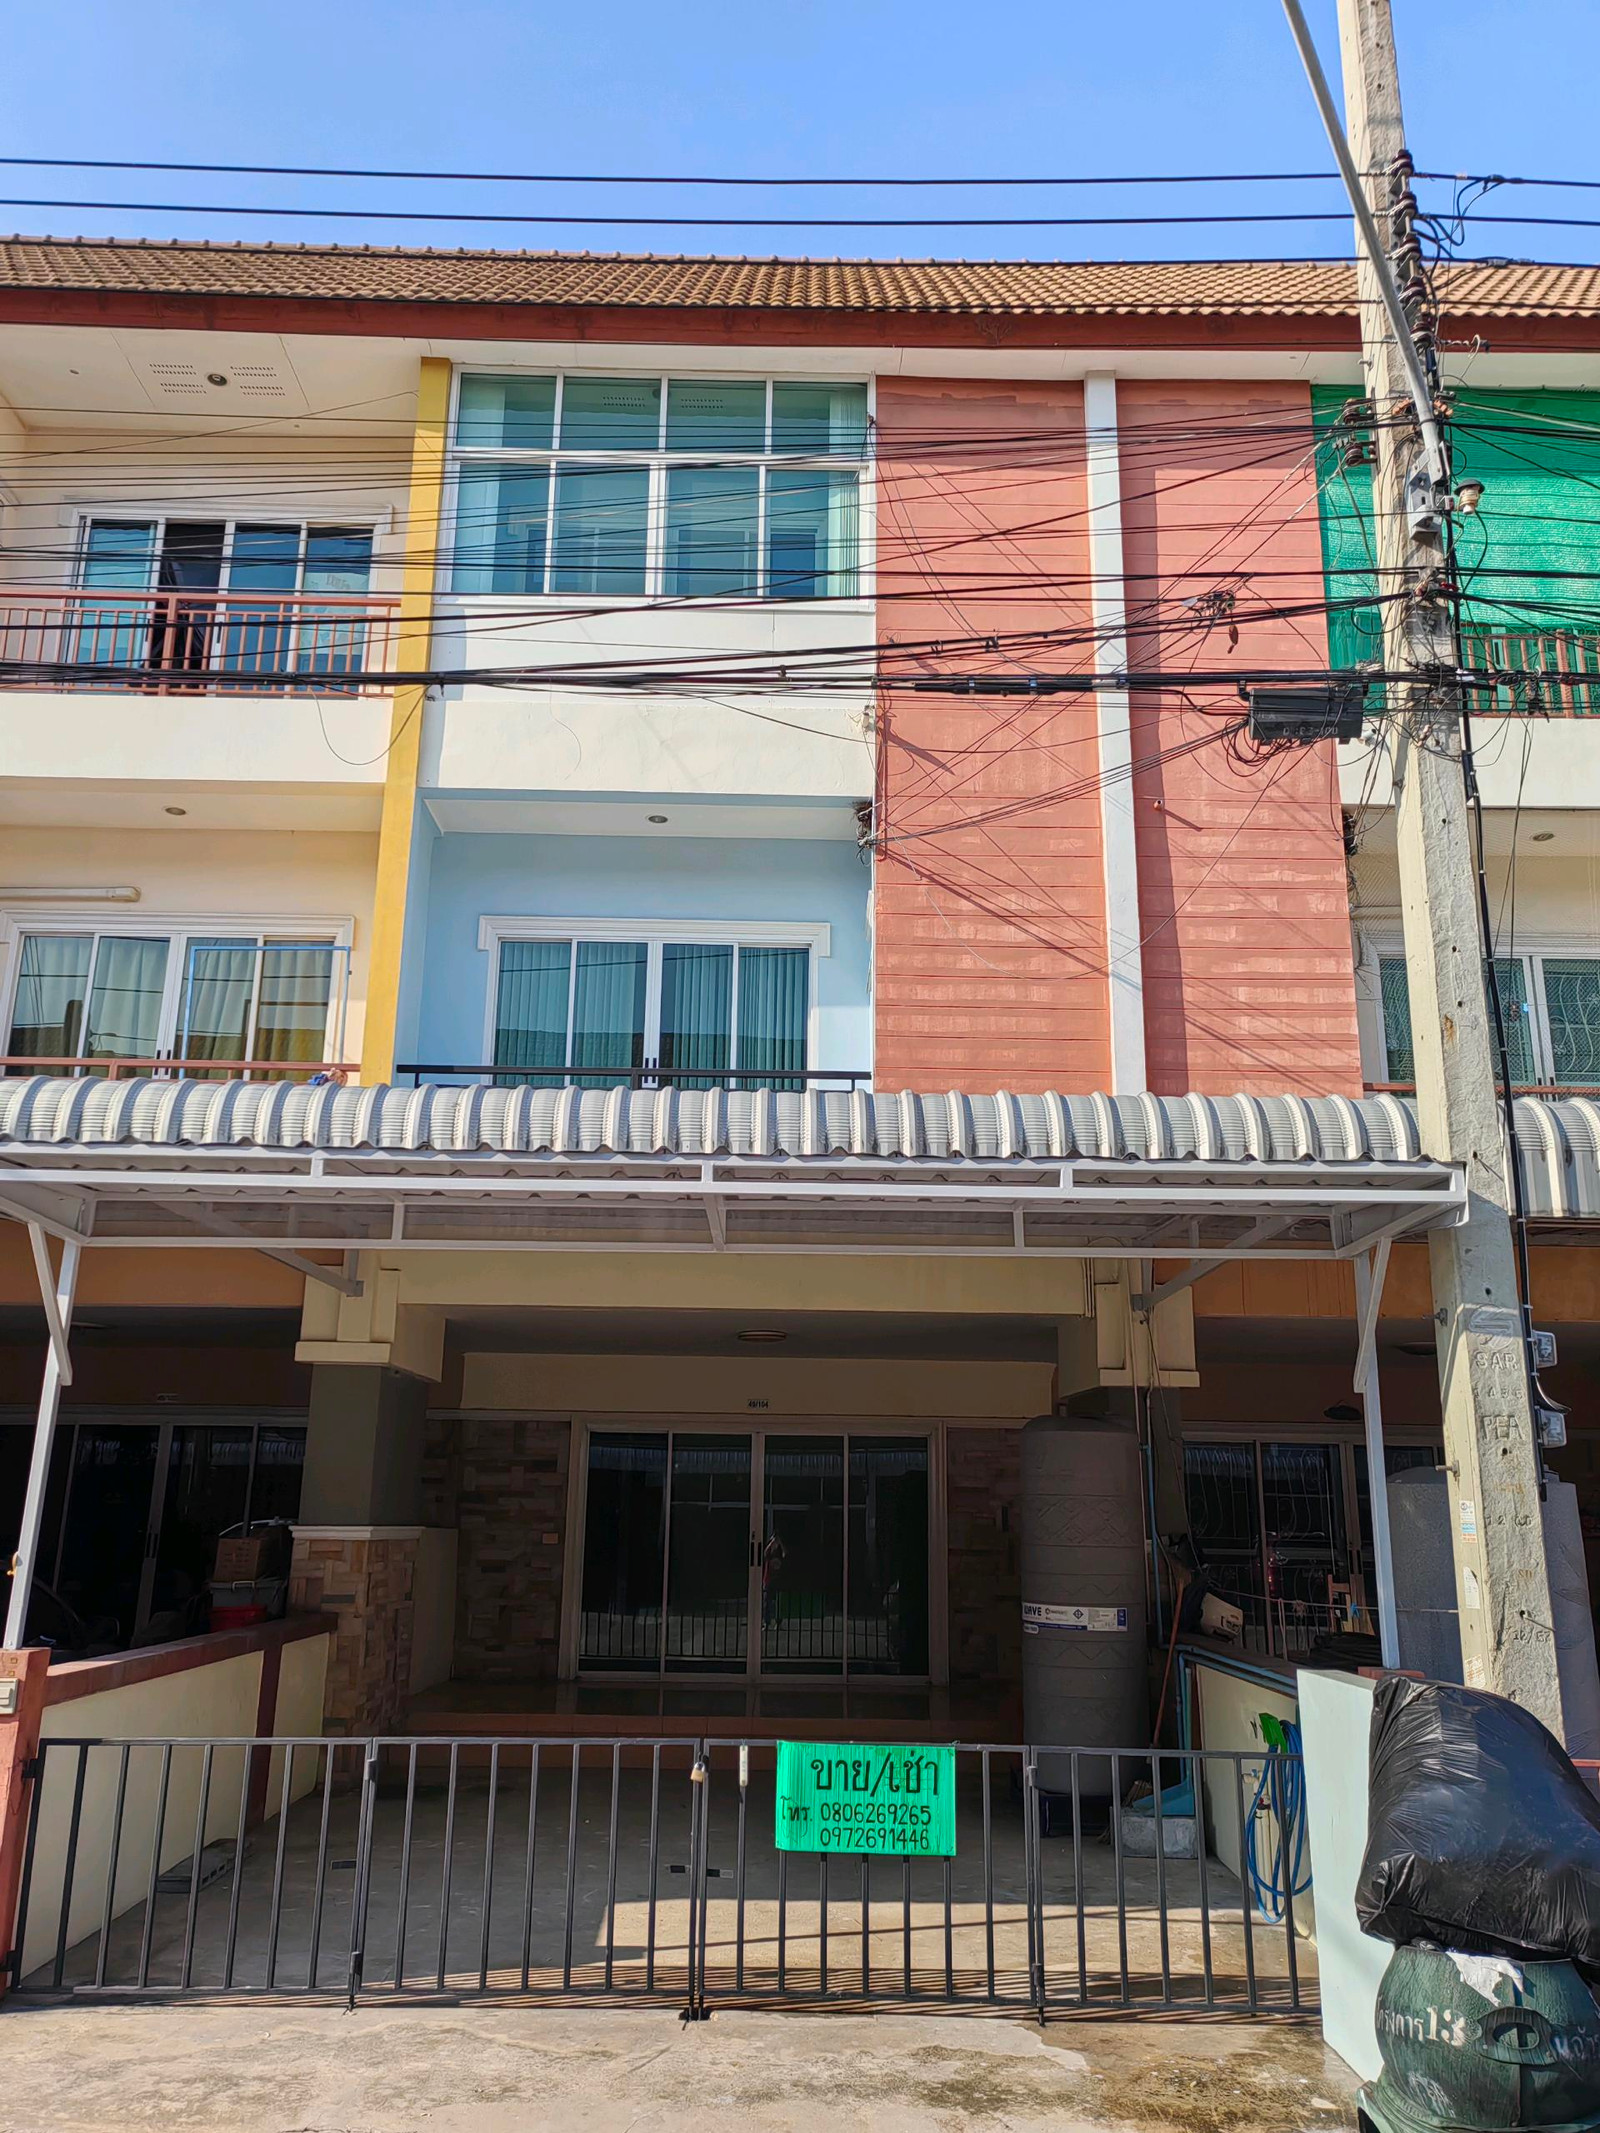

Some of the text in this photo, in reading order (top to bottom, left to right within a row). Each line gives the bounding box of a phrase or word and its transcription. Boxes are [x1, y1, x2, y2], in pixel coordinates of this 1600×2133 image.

[810, 1751, 938, 1797] ขาย/เช่า
[821, 1802, 931, 1826] 0806269265
[820, 1827, 929, 1850] 0972691446
